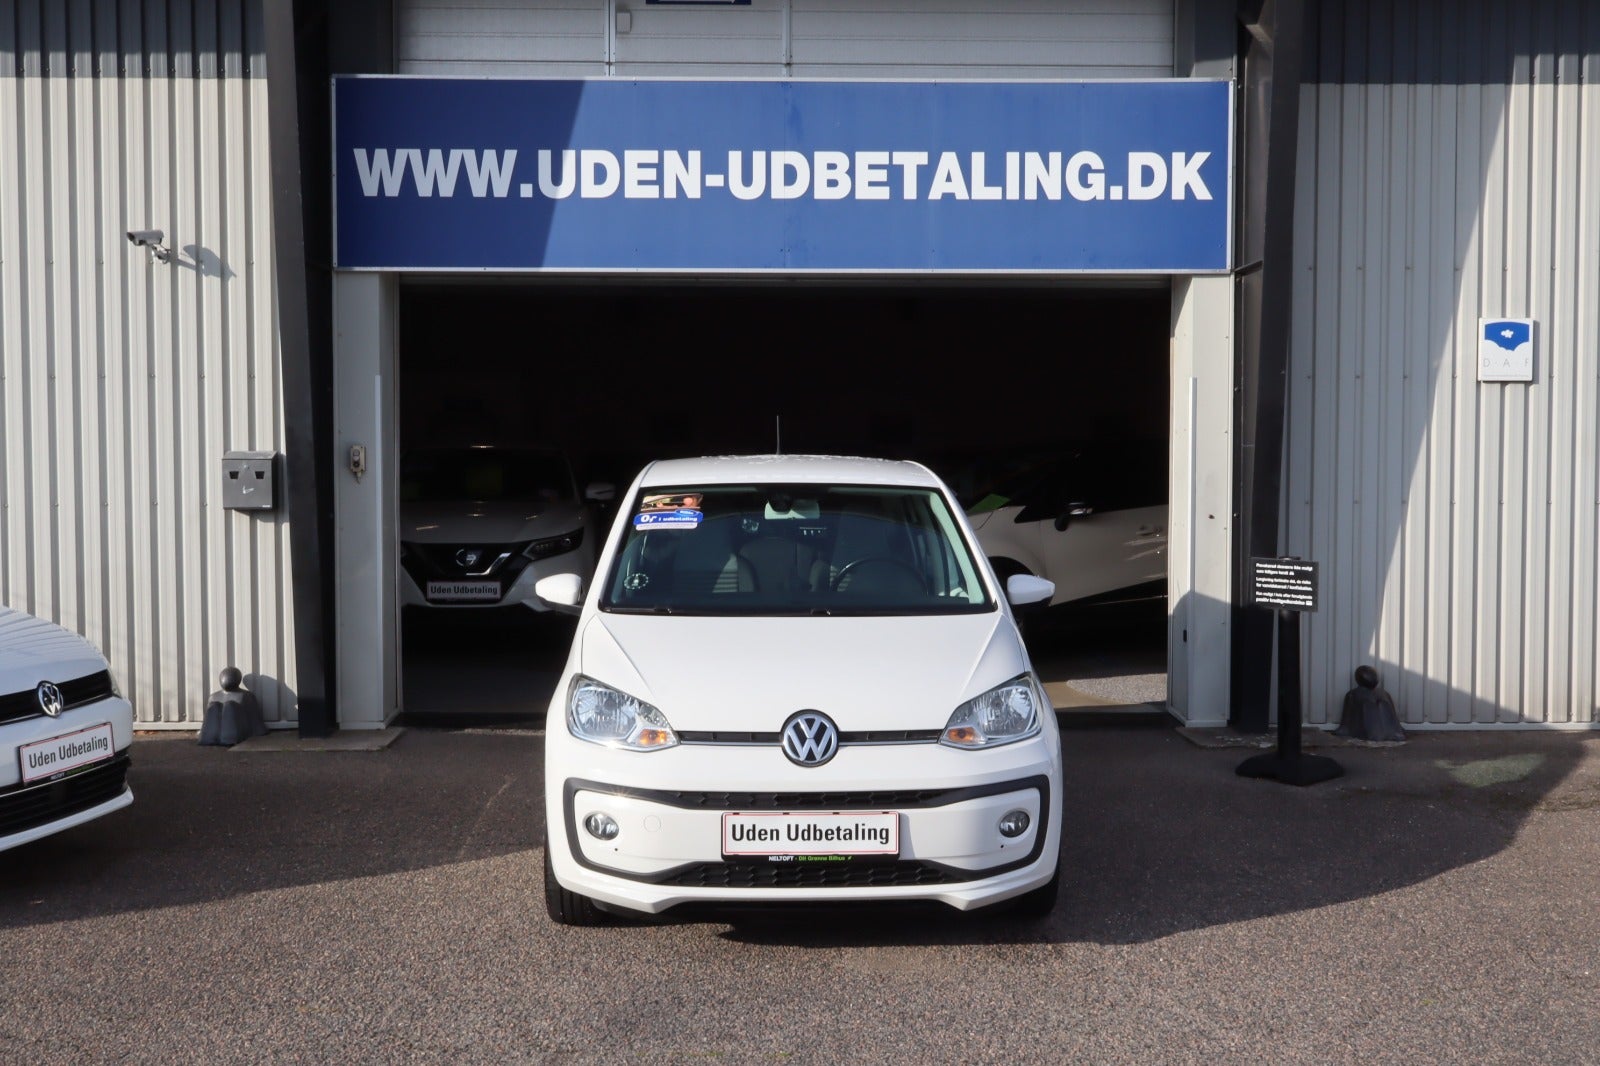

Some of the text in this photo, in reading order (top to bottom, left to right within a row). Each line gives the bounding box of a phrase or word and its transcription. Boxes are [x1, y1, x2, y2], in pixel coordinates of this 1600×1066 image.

[353, 148, 1213, 201] WWW.UDEN-UDBETALING.DK
[430, 585, 498, 595] Uden Udbetaling
[28, 736, 108, 769] Uden Udbetaling
[731, 823, 890, 845] Uden Udbetaling
